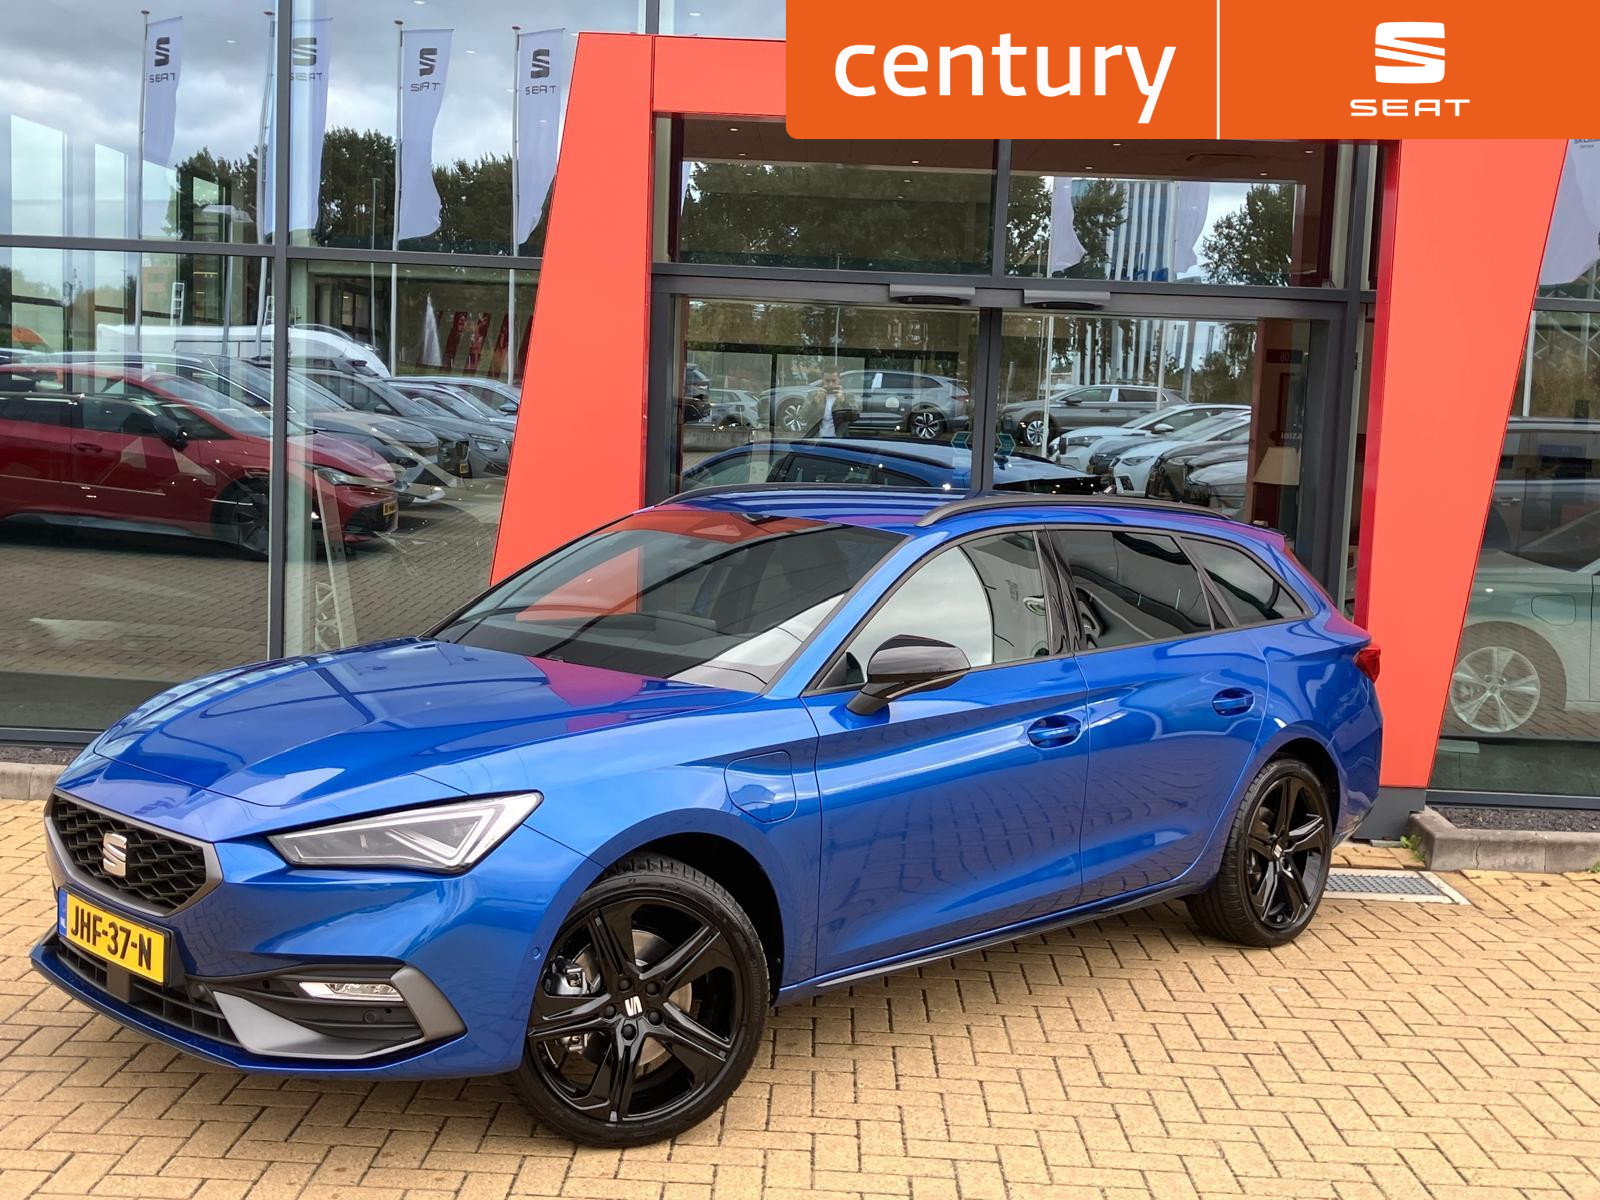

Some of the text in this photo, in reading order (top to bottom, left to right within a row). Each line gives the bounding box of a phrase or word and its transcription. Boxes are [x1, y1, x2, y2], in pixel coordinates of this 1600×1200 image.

[149, 72, 176, 84] SEAT
[525, 84, 557, 95] SEAT
[70, 905, 152, 971] JHF-37-N
